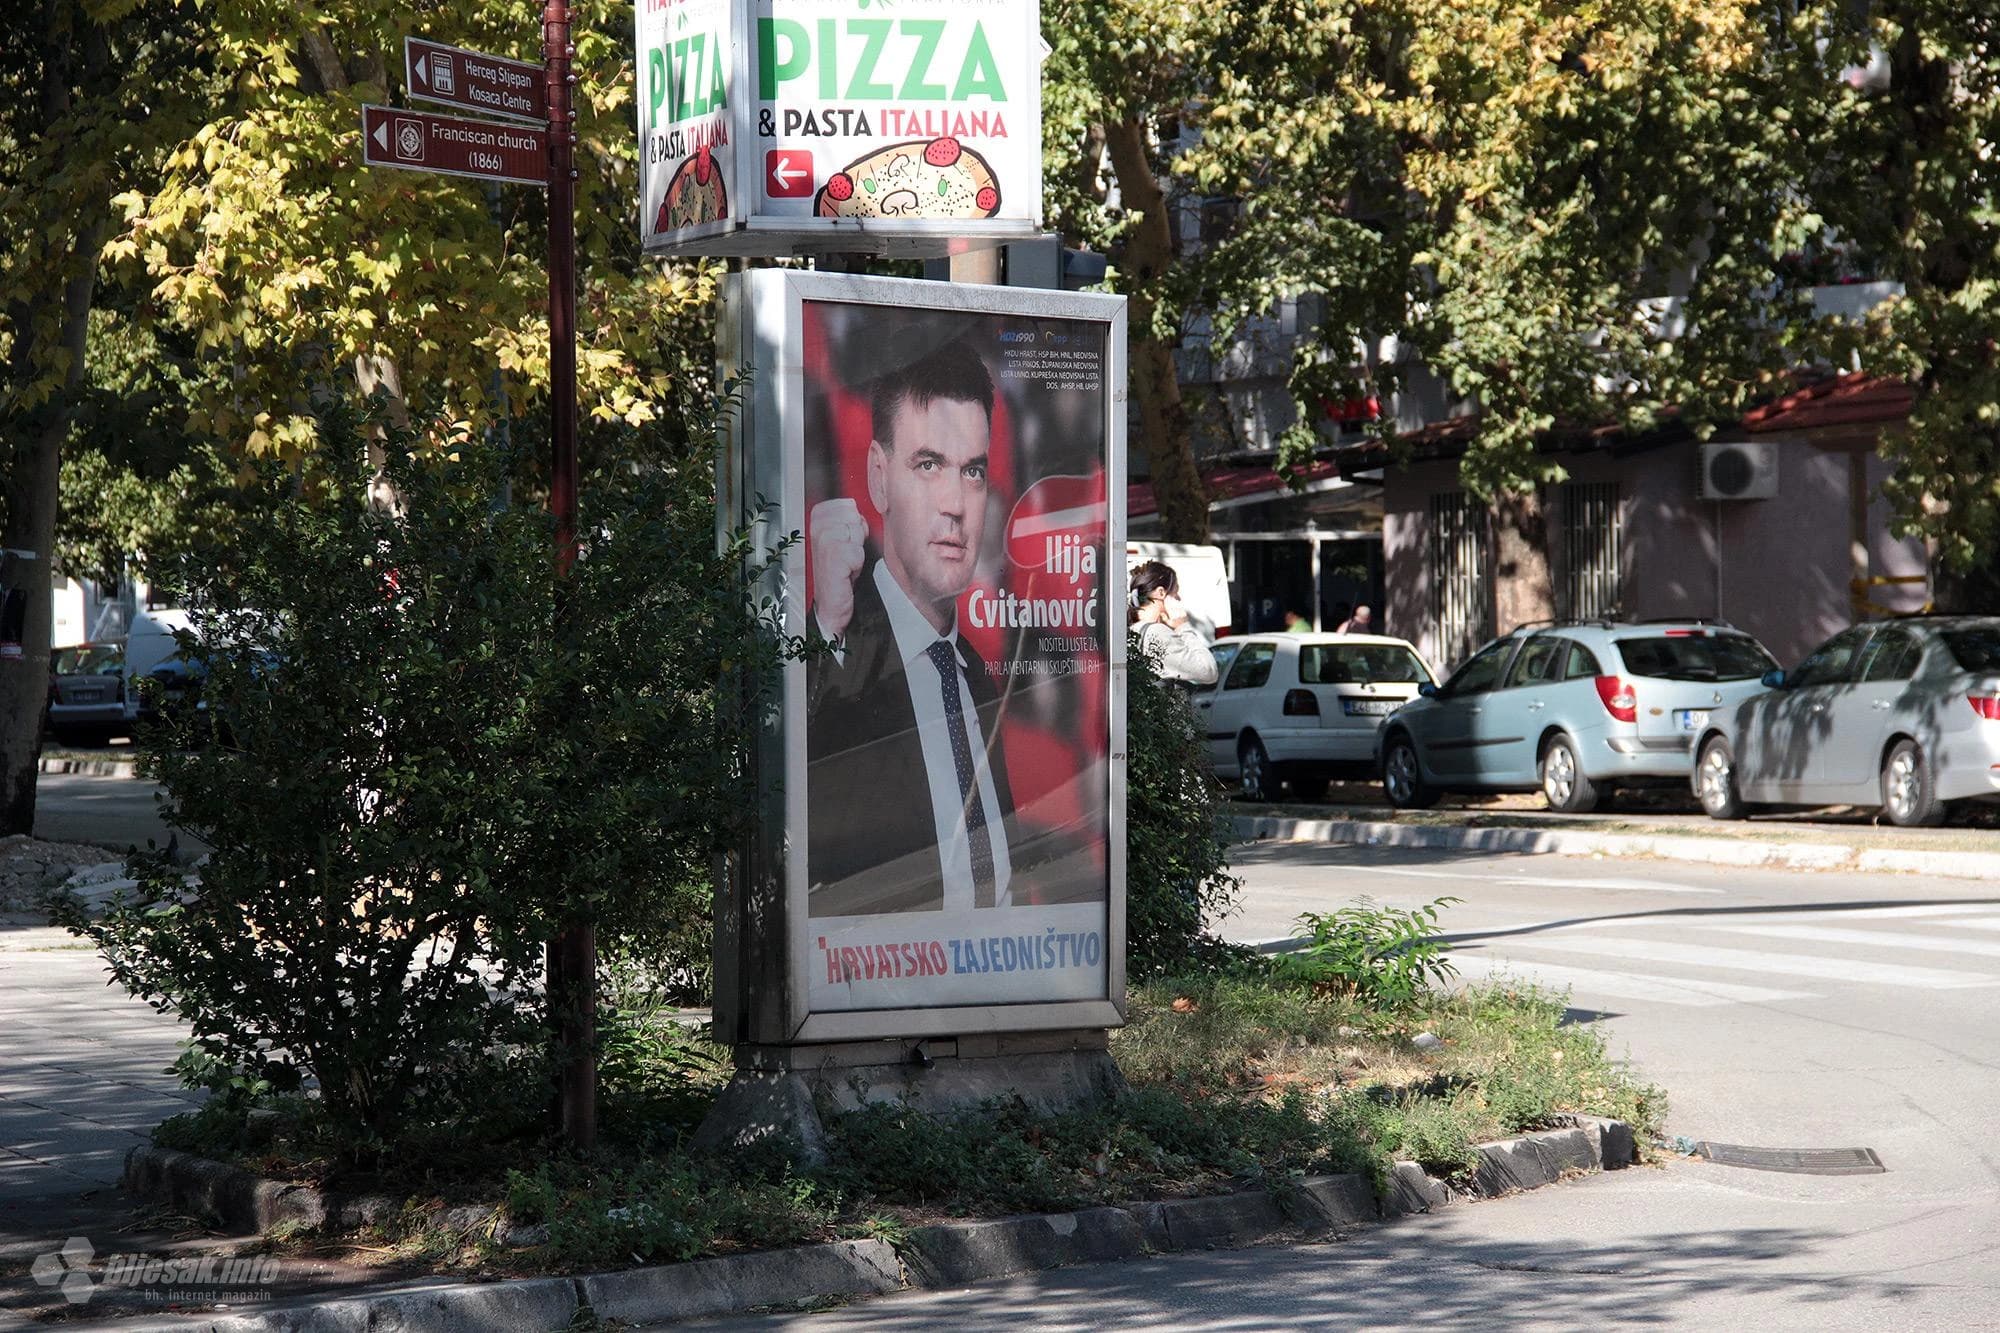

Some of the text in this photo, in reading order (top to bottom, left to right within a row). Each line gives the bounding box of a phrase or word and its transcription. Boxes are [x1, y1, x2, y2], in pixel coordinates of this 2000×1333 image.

[465, 60, 532, 89] Herceg Stjepan
[757, 17, 1008, 102] PIZZA
[648, 27, 727, 128] PIZZA
[468, 83, 532, 112] Kosaca Centre
[432, 123, 537, 151] Franciscan church
[758, 108, 1009, 139] & PASTA ITALIANA
[650, 119, 728, 164] & PASTA ITALIANA
[468, 151, 503, 172] (1866)
[1046, 534, 1097, 584] Ilija
[968, 588, 1097, 628] Cvitanović
[1088, 637, 1099, 650] ZA
[826, 927, 1101, 984] HRVATSKO ZAJEDNIŠTVO
